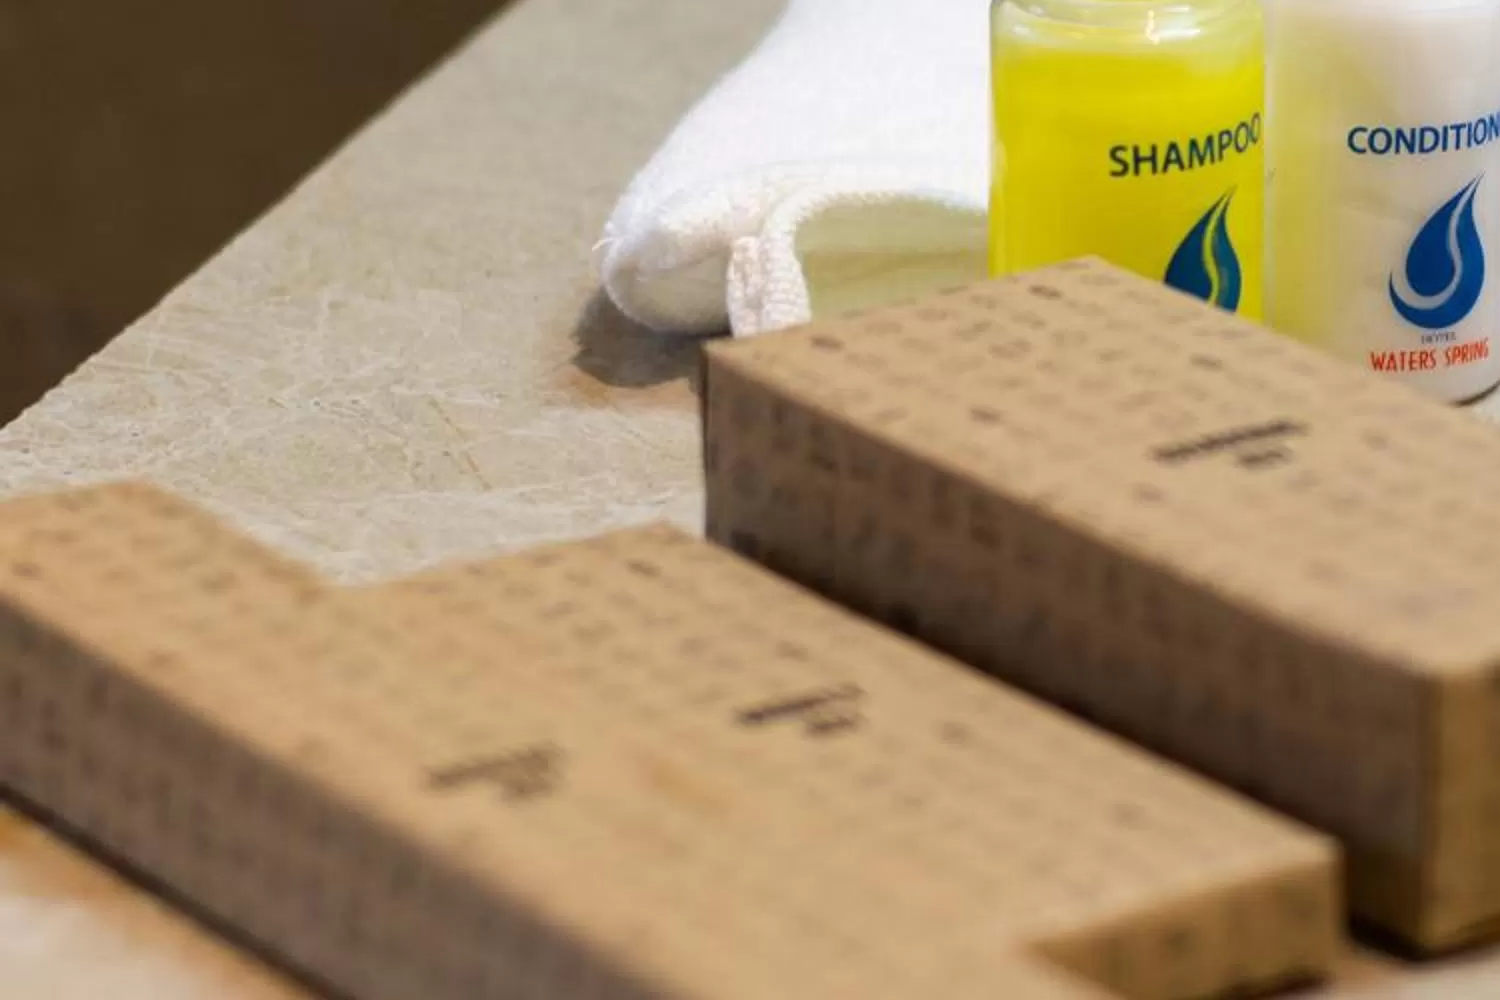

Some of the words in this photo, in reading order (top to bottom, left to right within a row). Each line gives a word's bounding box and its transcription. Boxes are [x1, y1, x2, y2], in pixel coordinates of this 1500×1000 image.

[1109, 112, 1261, 177] SHAMPOO
[1370, 349, 1437, 372] WATERS
[1444, 336, 1489, 367] SPRING
